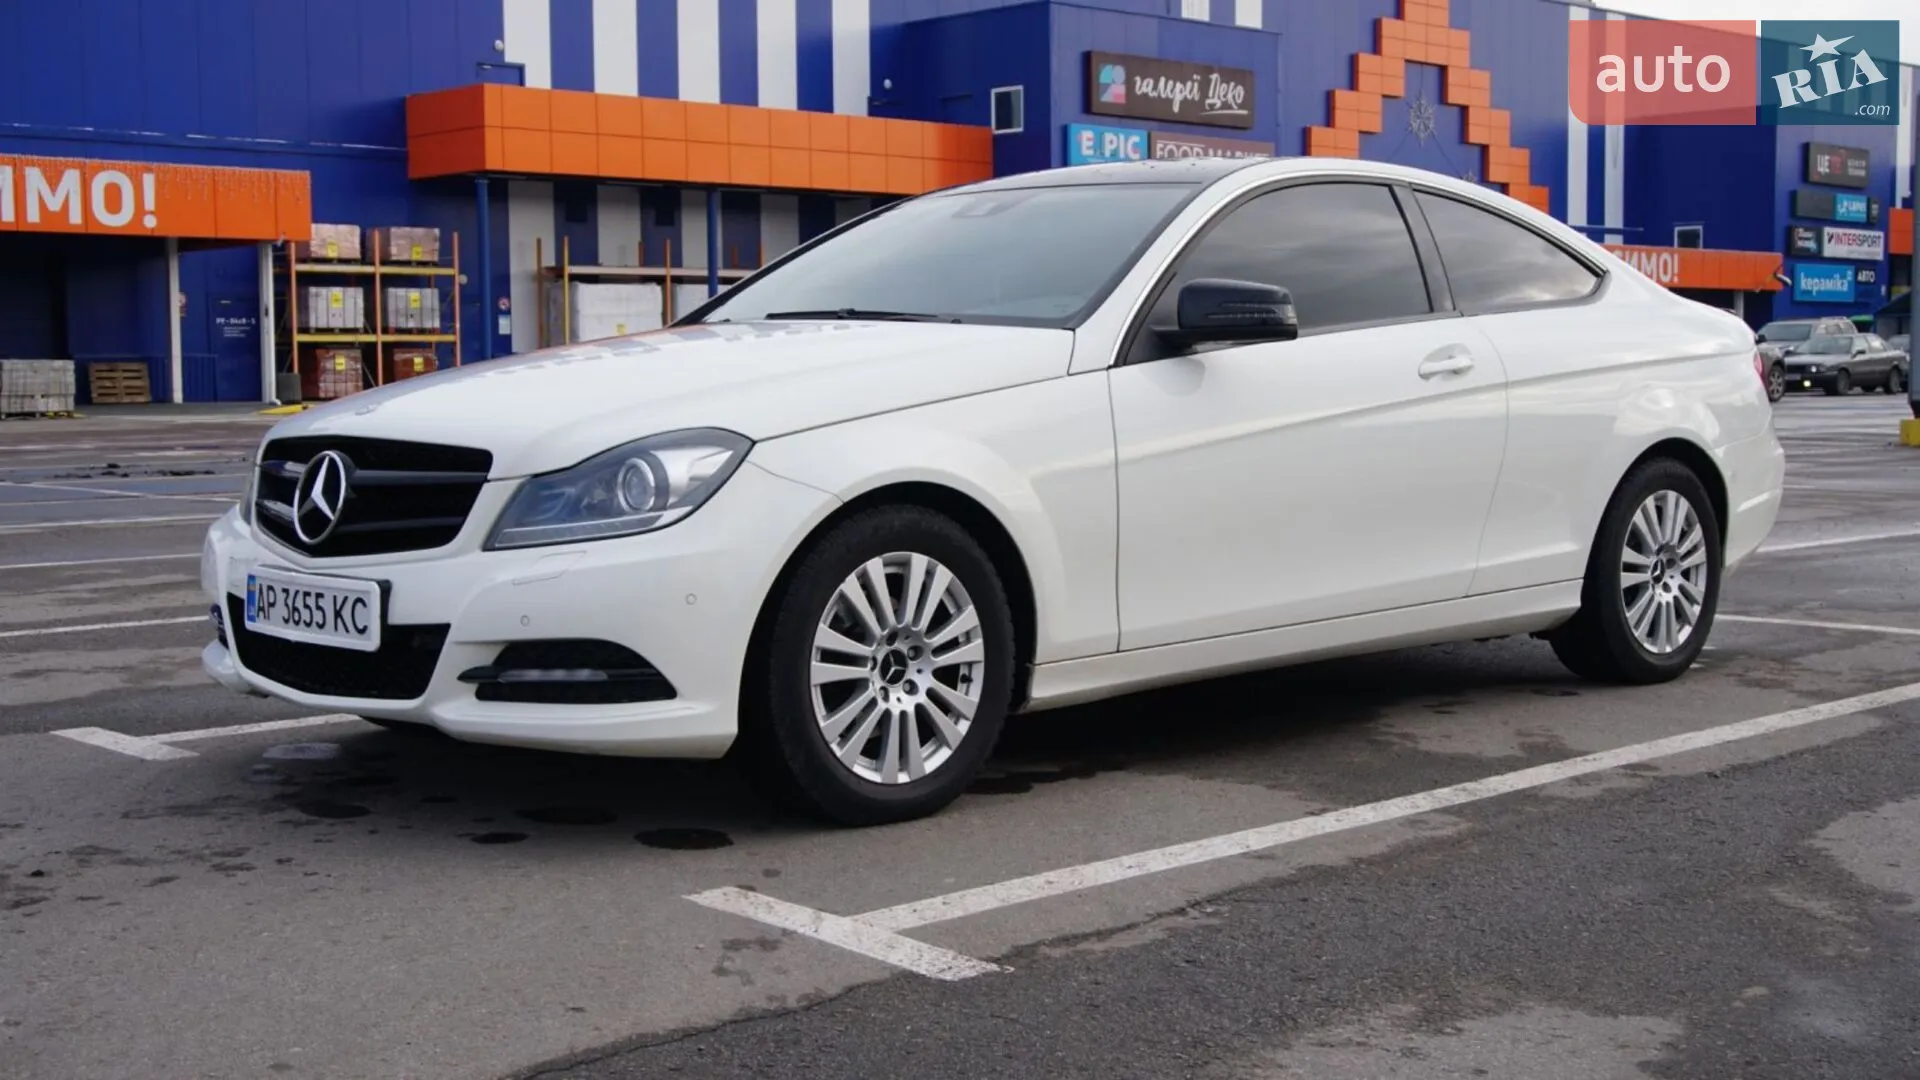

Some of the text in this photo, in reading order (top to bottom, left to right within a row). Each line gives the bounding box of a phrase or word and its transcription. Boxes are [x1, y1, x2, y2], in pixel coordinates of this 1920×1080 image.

[1204, 72, 1245, 111] Деко
[1834, 231, 1882, 248] INTERSPORT
[256, 583, 368, 634] AP 3655 KC
